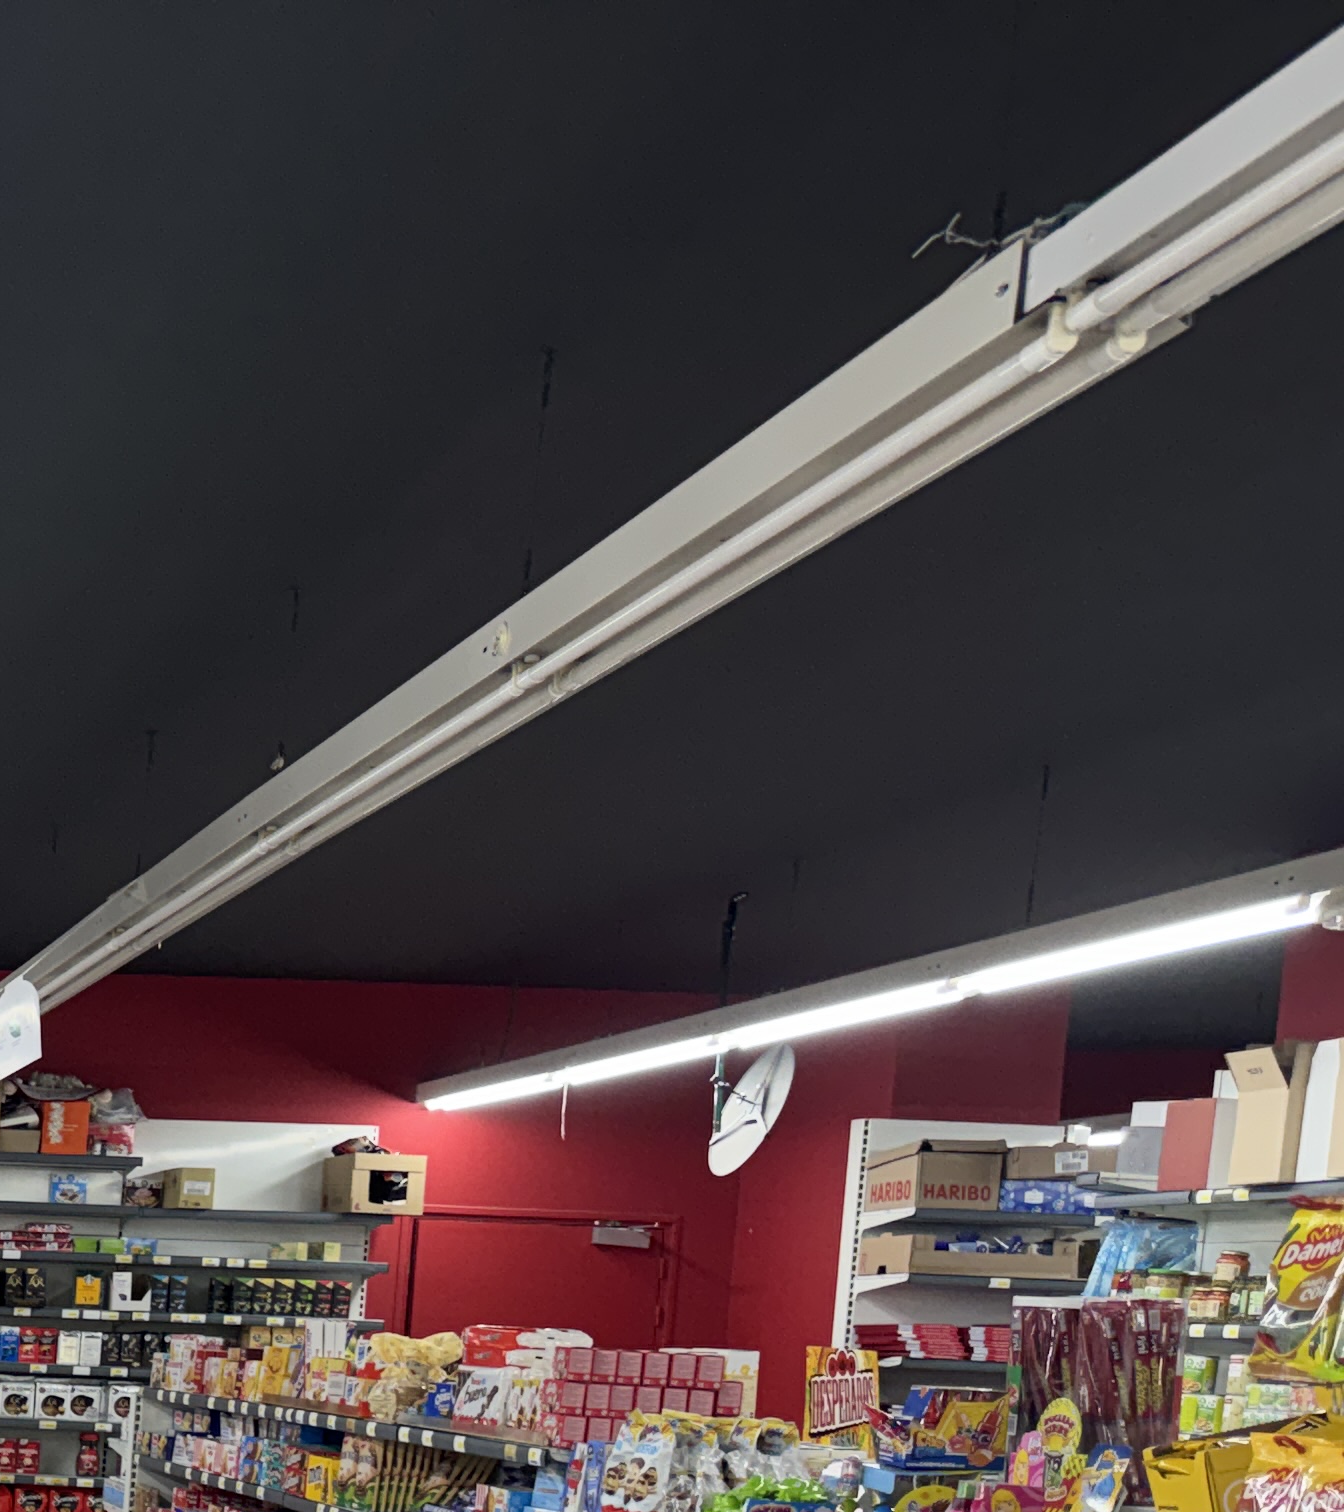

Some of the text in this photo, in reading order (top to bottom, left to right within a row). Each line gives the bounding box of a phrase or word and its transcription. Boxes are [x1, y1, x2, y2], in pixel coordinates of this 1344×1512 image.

[870, 1179, 911, 1203] HARIBO
[922, 1183, 992, 1202] HARIBO
[463, 1385, 488, 1405] bueno
[812, 1376, 876, 1431] DESPERADOS
